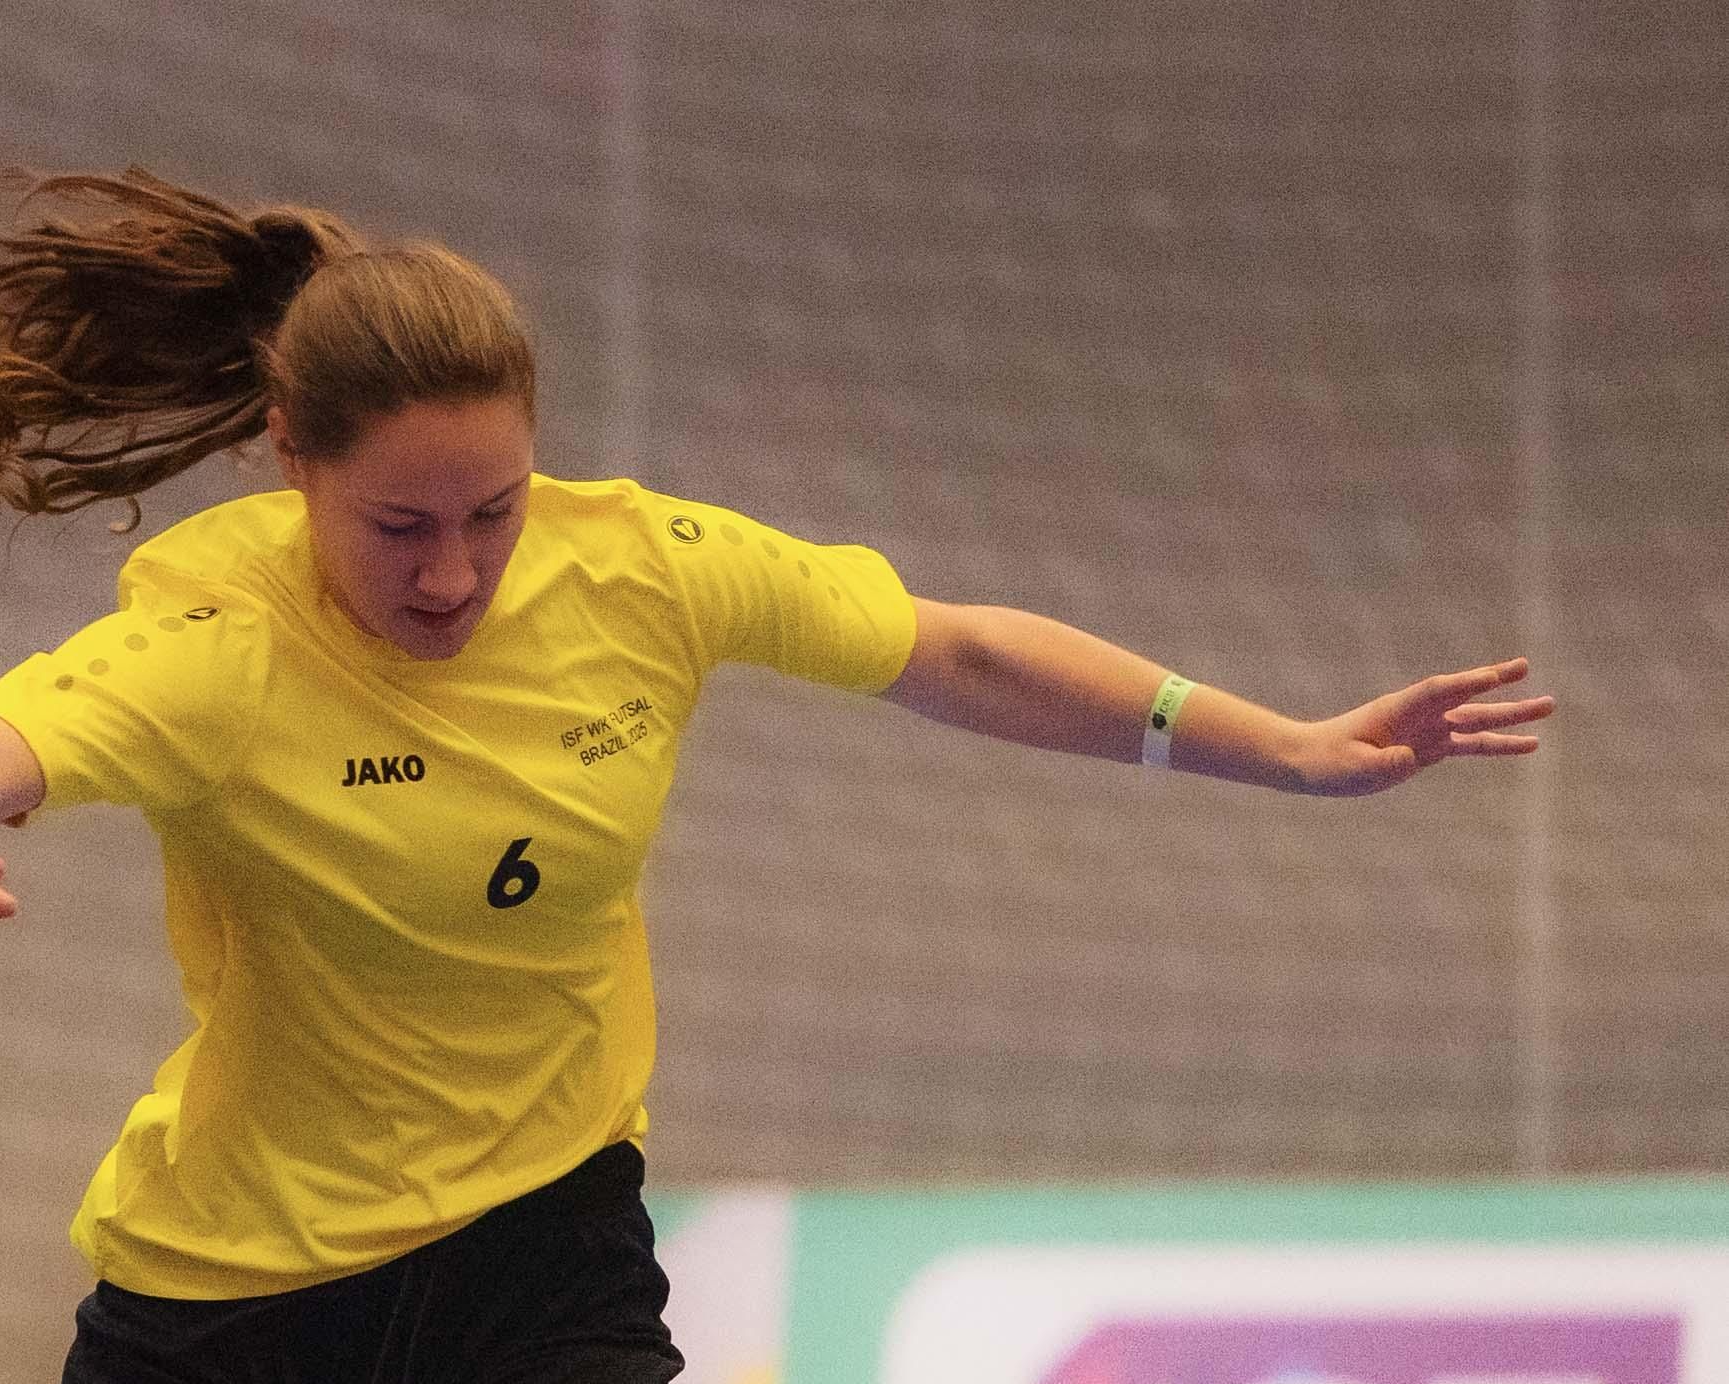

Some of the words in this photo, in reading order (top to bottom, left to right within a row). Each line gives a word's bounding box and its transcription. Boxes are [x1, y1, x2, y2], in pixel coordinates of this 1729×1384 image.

[561, 726, 584, 750] ISF
[586, 716, 612, 738] WK
[580, 735, 629, 767] BRAZIL
[341, 754, 426, 787] JAKO
[486, 837, 541, 909] 6
